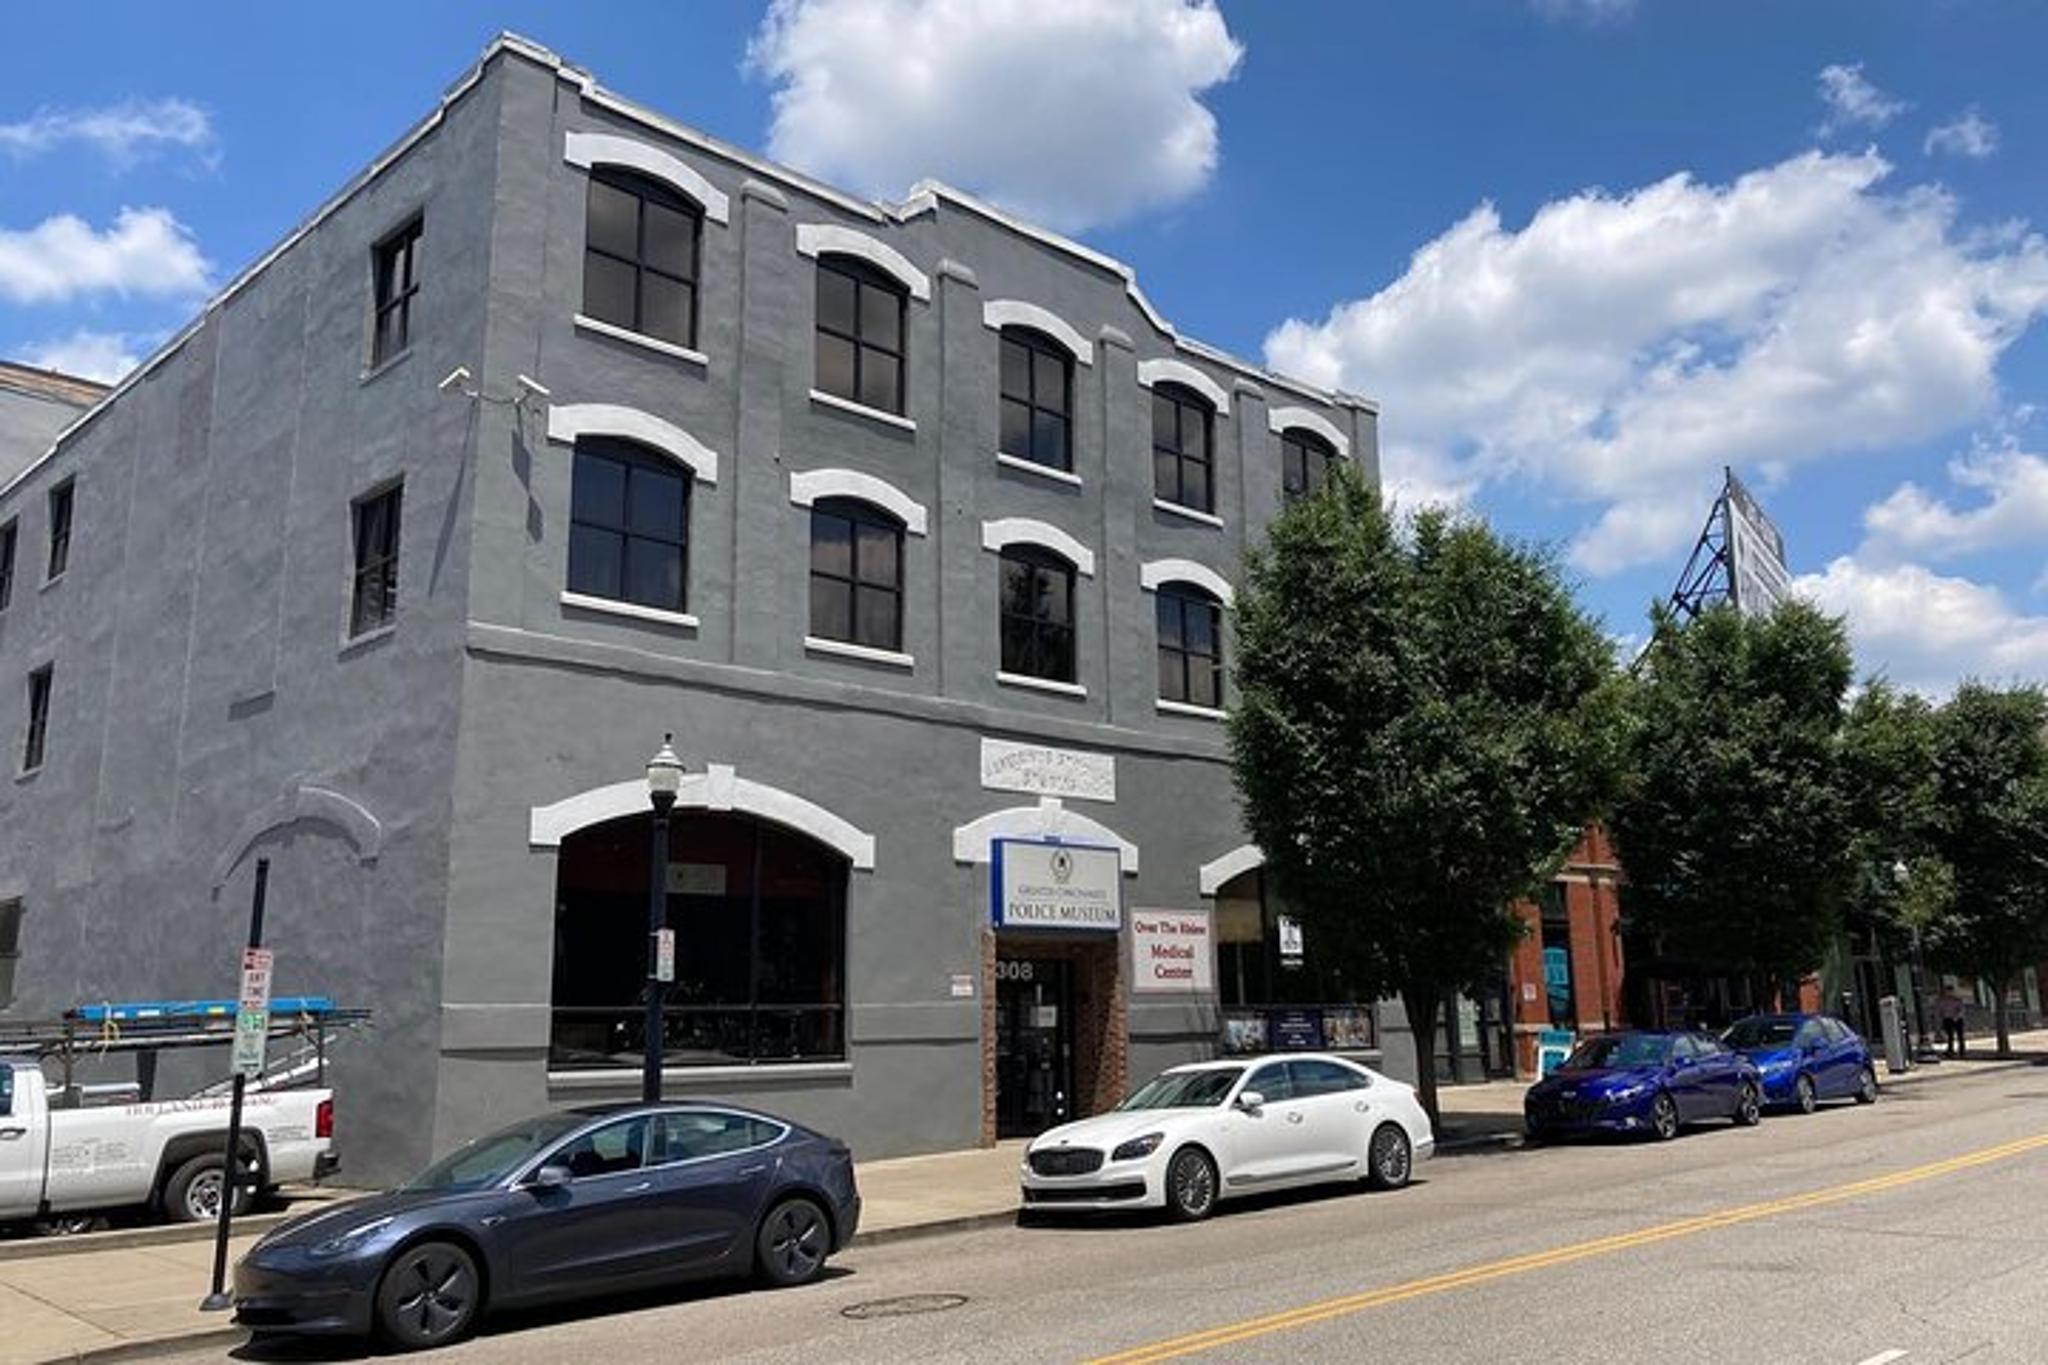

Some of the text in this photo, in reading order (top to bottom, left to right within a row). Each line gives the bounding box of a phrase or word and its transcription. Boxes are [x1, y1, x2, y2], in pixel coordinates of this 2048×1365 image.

[1008, 903, 1117, 923] POLICE MUSEUM
[1135, 920, 1158, 934] Over
[1160, 921, 1178, 934] The
[1151, 944, 1195, 959] Medical
[1154, 963, 1193, 979] Center
